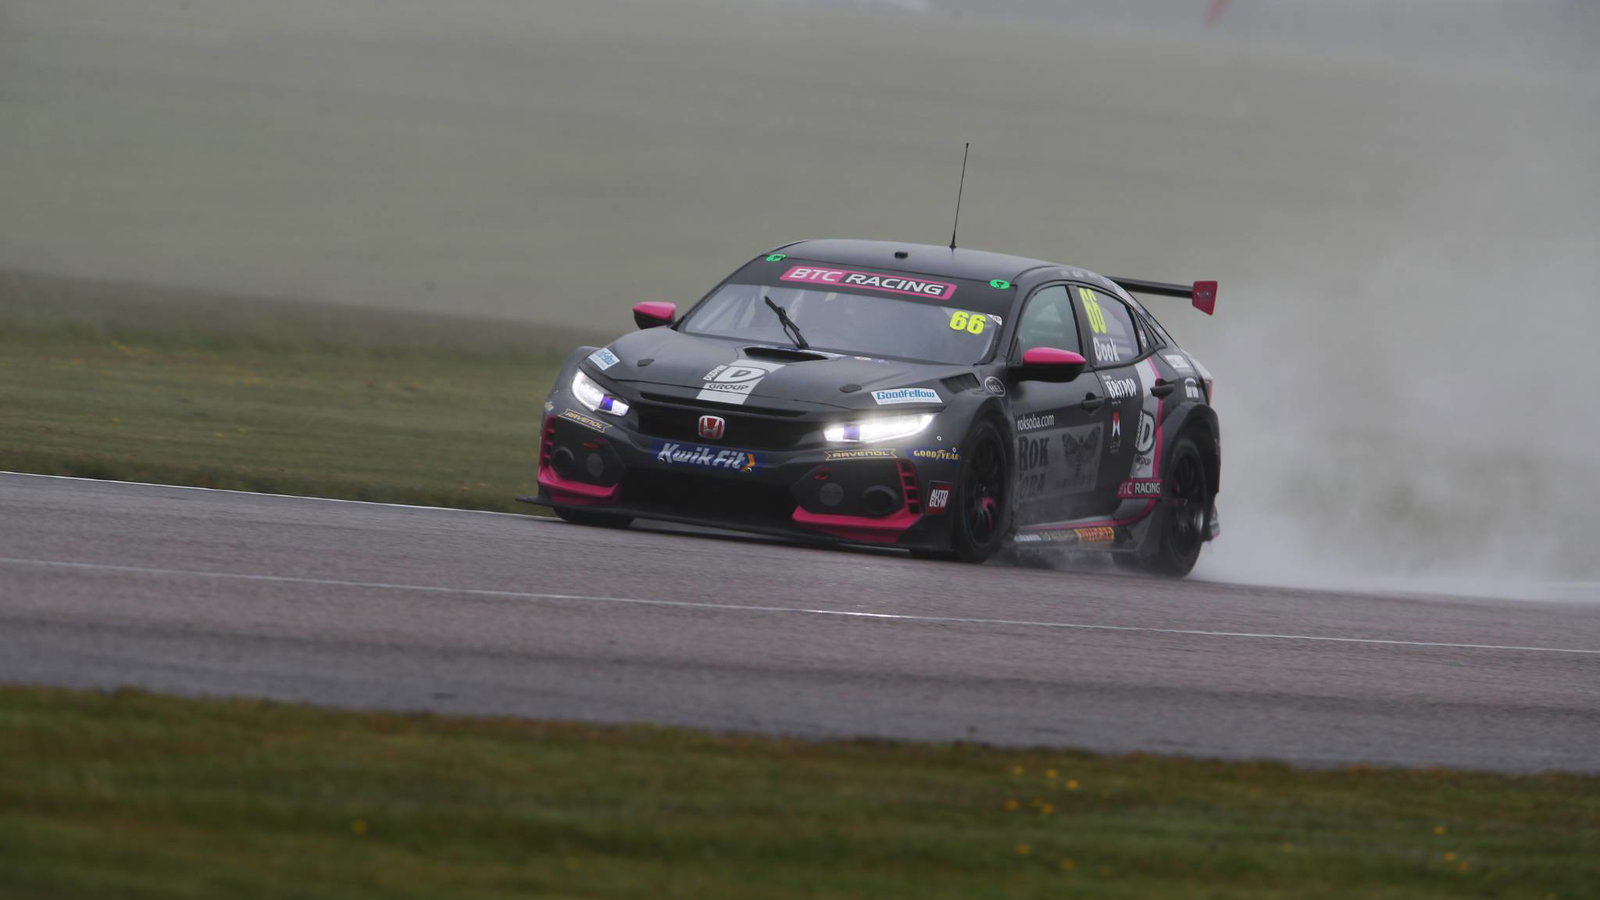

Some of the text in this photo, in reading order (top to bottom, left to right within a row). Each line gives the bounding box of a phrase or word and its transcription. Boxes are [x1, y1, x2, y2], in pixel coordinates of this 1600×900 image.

[789, 268, 945, 296] BTC RACING
[1079, 287, 1107, 335] 66
[950, 311, 986, 335] 66
[708, 383, 749, 391] GROUP
[565, 411, 603, 430] RAVENOL
[1017, 414, 1055, 431] roksoba.com
[833, 451, 891, 459] RAVENOL
[930, 489, 948, 500] AUTO
[1134, 482, 1161, 495] RACING
